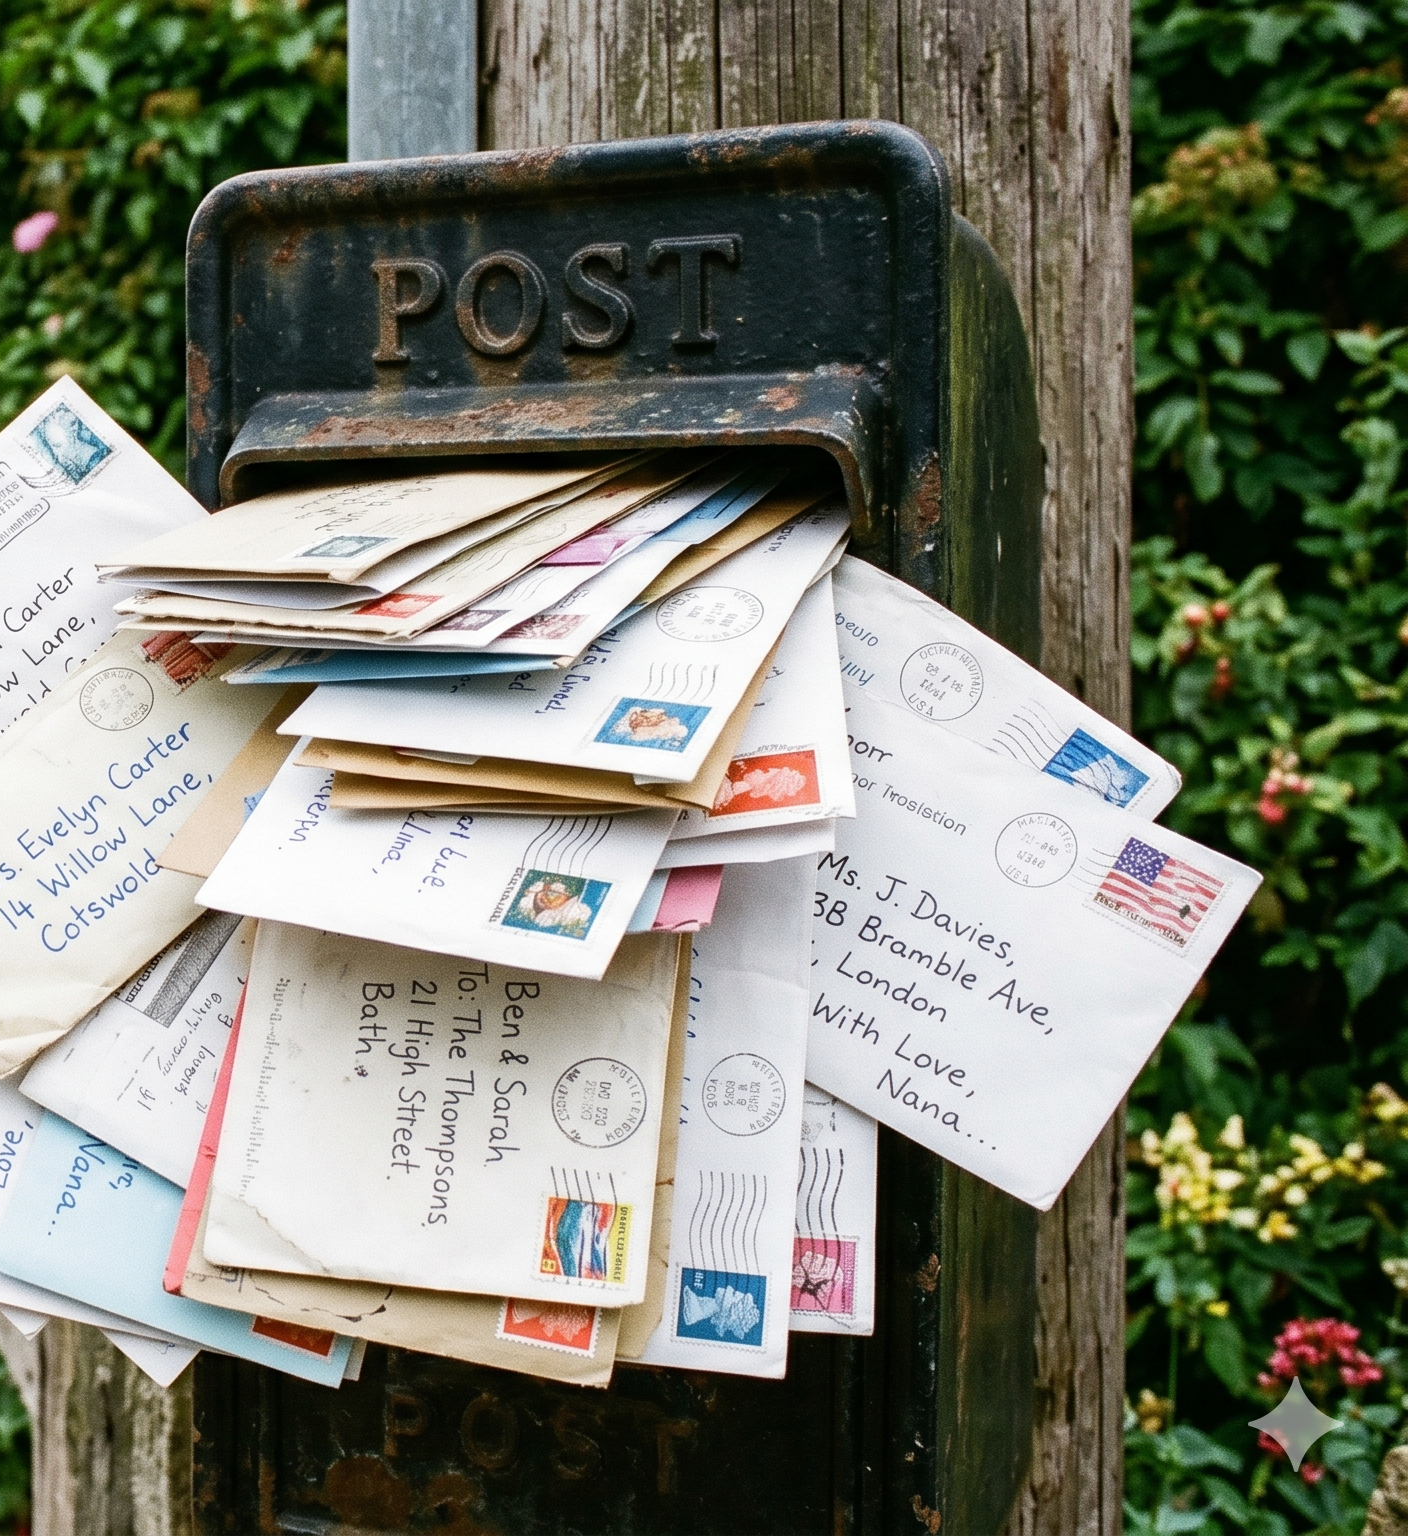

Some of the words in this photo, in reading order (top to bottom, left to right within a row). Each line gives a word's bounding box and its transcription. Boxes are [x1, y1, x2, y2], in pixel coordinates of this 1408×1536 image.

[372, 234, 743, 365] POST
[2, 566, 74, 633] Carter
[21, 615, 96, 666] Lane,
[16, 794, 107, 860] Evelyn
[108, 721, 191, 790] Carter
[0, 899, 35, 930] 14
[36, 826, 127, 897] Willow
[128, 771, 213, 827] Lane,
[41, 847, 163, 953] Cotswold
[817, 851, 861, 891] Ms.
[875, 874, 908, 907] J.
[910, 889, 1015, 968] Davies,
[409, 979, 438, 1006] 21
[457, 962, 490, 1001] To:
[812, 891, 848, 926] 3B
[857, 915, 978, 991] Bramble
[988, 978, 1054, 1036] Ave,
[836, 950, 948, 1023] London
[448, 1008, 482, 1060] The
[500, 981, 540, 1039] Ben
[812, 992, 880, 1046] With
[894, 1033, 975, 1098] Love,
[387, 1018, 435, 1077] High
[498, 1048, 530, 1065] &
[876, 1068, 997, 1151] Nana...
